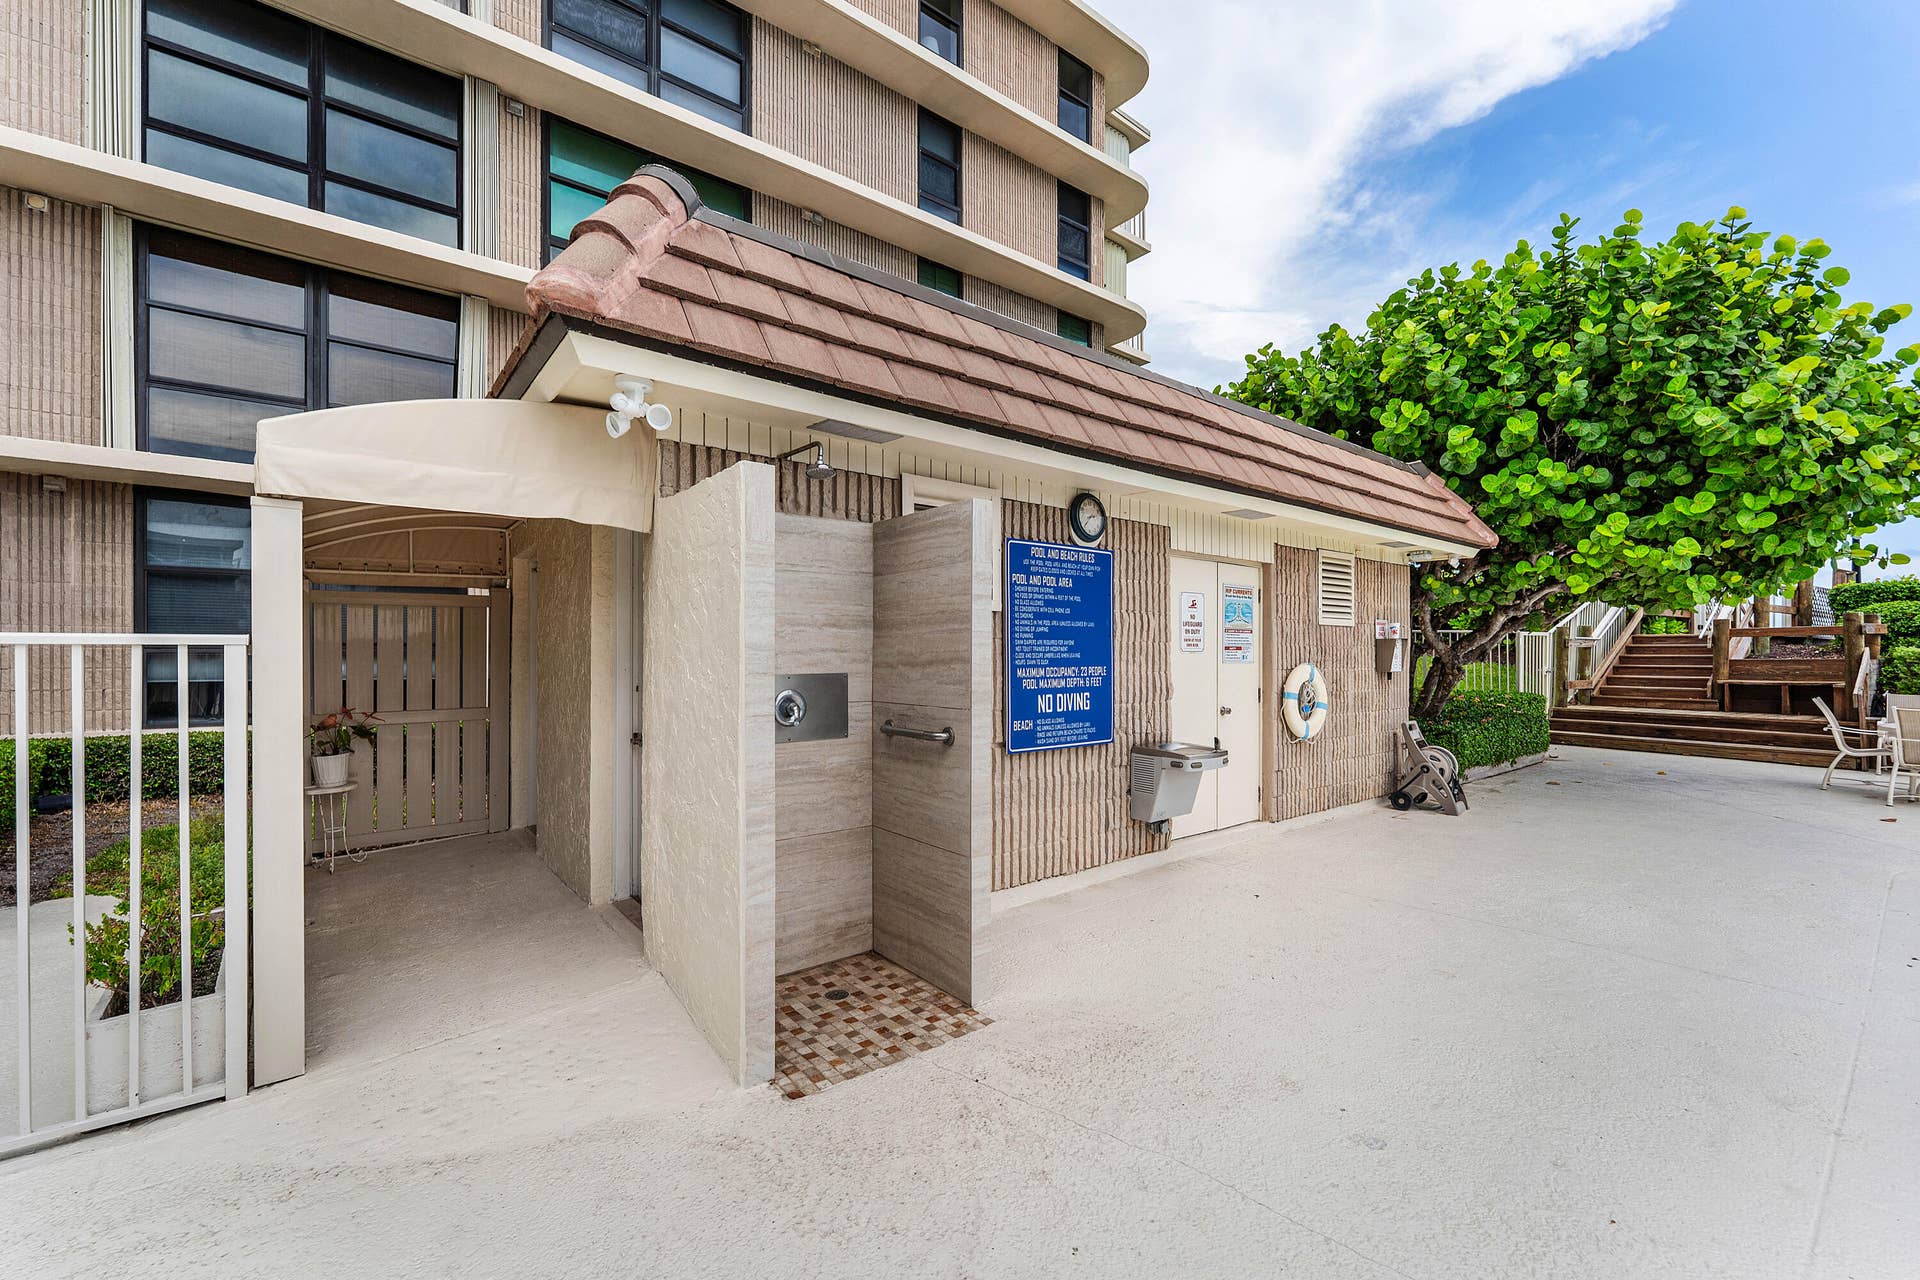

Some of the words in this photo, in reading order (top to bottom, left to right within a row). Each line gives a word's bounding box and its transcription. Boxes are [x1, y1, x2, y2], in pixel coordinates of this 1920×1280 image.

[1031, 547, 1045, 558] POOL
[1048, 549, 1059, 559] AND
[1061, 550, 1077, 561] BEACH
[1079, 552, 1094, 563] RULES
[1012, 574, 1027, 584] POOL
[1029, 575, 1041, 585] AND
[1043, 576, 1056, 586] POOL
[1059, 577, 1072, 587] AREA
[1017, 668, 1044, 678] MAXIMUM
[1046, 667, 1079, 677] OCCUPANCY:
[1081, 667, 1087, 676] 23
[1088, 666, 1106, 676] PEOPLE
[1023, 679, 1038, 689] POOL
[1039, 678, 1065, 689] MAXIMUM
[1067, 678, 1084, 687] DEPTH:
[1086, 678, 1089, 687] 6
[1091, 677, 1102, 686] FEET
[1038, 694, 1052, 713] NO
[1057, 692, 1090, 712] DIVING
[1013, 720, 1033, 731] BEACH
